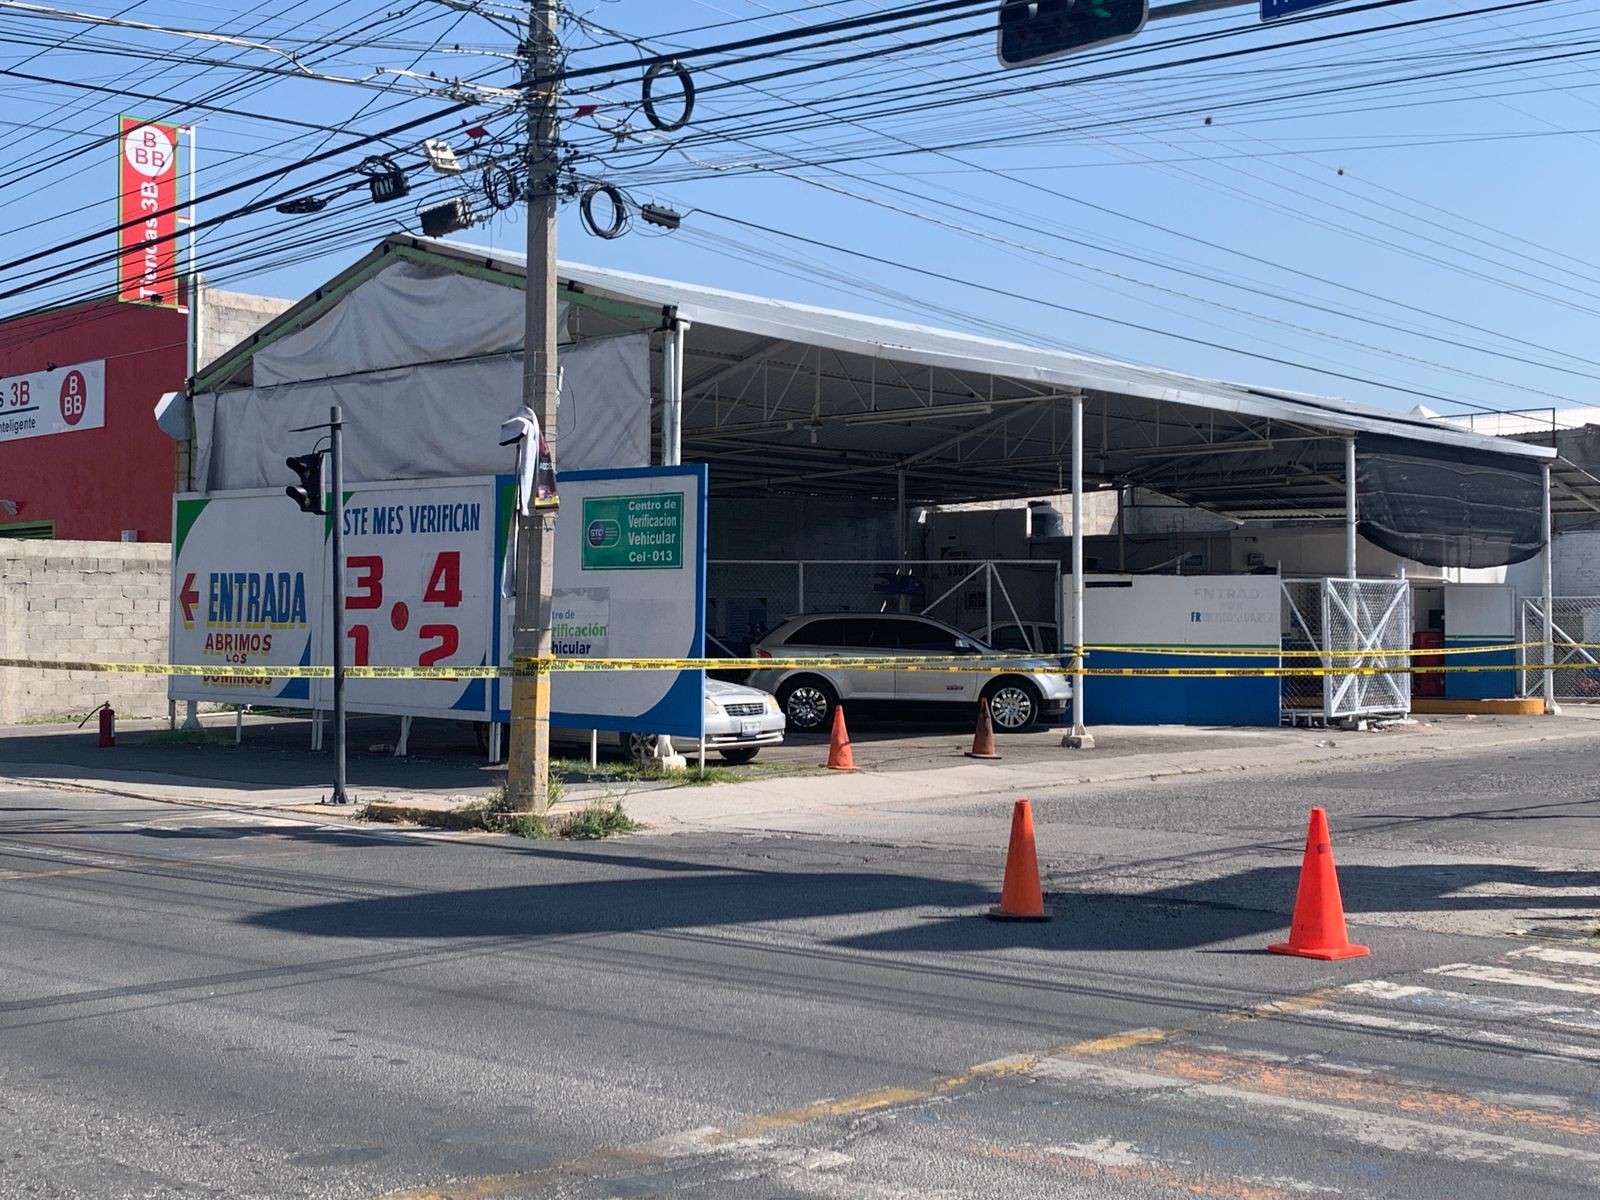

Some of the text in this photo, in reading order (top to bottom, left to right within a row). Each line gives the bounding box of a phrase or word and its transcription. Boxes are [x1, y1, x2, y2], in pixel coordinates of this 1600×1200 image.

[140, 181, 159, 211] 3B
[10, 380, 30, 407] 3B
[628, 499, 677, 511] Centro de
[343, 503, 480, 536] STE MES VERIFICAN
[628, 512, 677, 528] Verificacion
[628, 530, 676, 546] Vehicular
[344, 550, 463, 610] 3 4
[208, 572, 307, 626] ENTRADA
[552, 609, 575, 620] tro de
[552, 621, 607, 637] rificación
[204, 632, 273, 653] ABRIMOS
[552, 640, 591, 655] hicular
[226, 653, 247, 664] LOS
